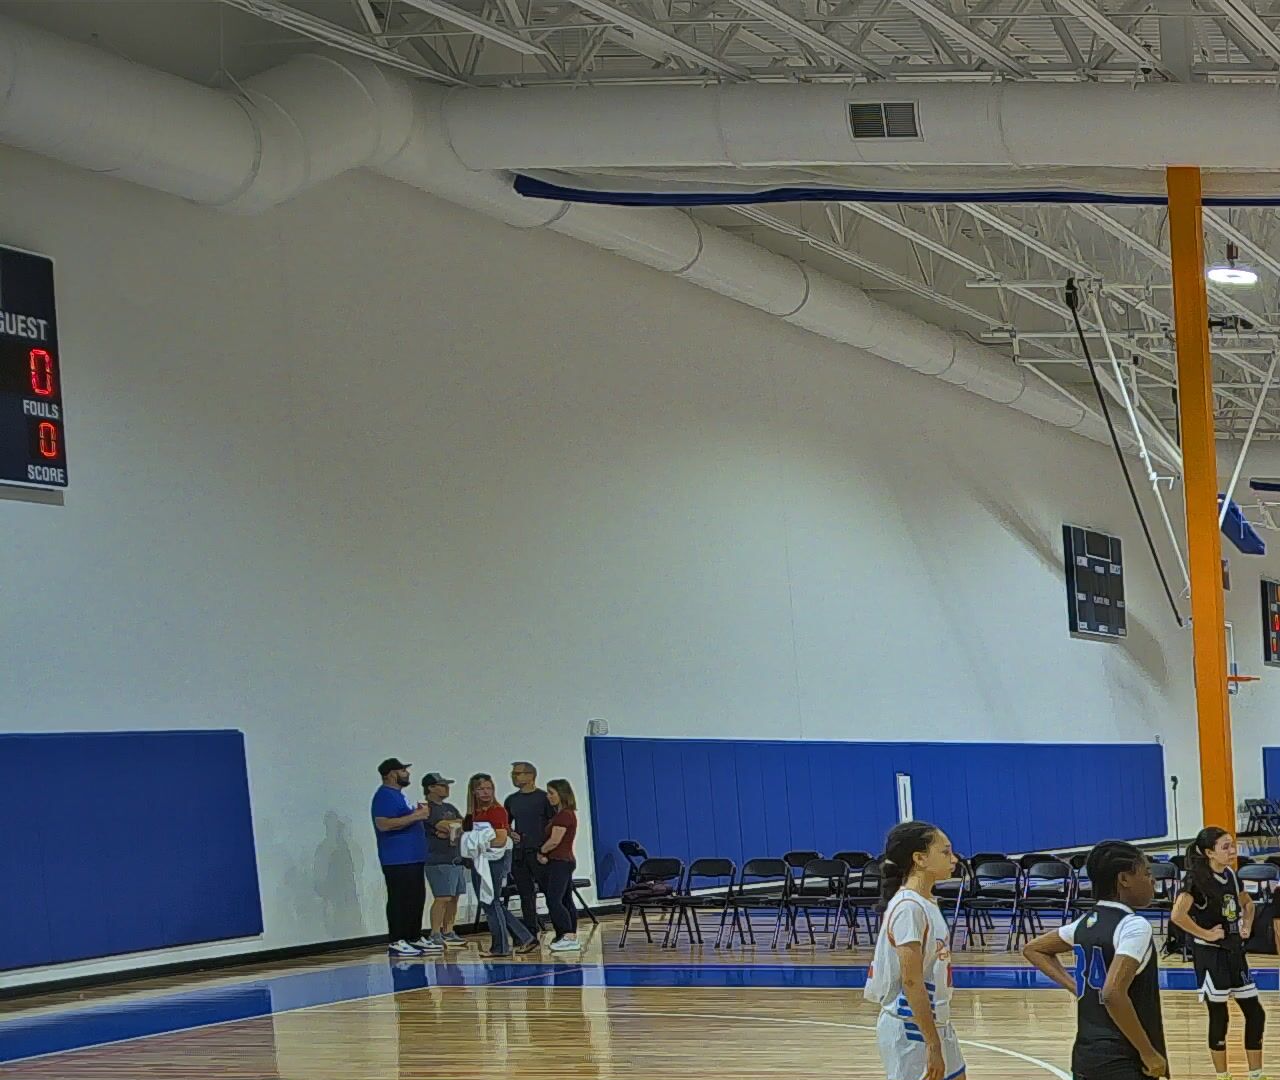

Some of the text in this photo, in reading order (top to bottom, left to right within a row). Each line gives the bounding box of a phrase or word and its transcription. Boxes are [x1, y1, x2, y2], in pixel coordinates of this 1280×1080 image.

[30, 349, 51, 395] 0
[23, 399, 59, 419] FOULS
[39, 422, 56, 457] 0
[27, 464, 65, 484] SCORE
